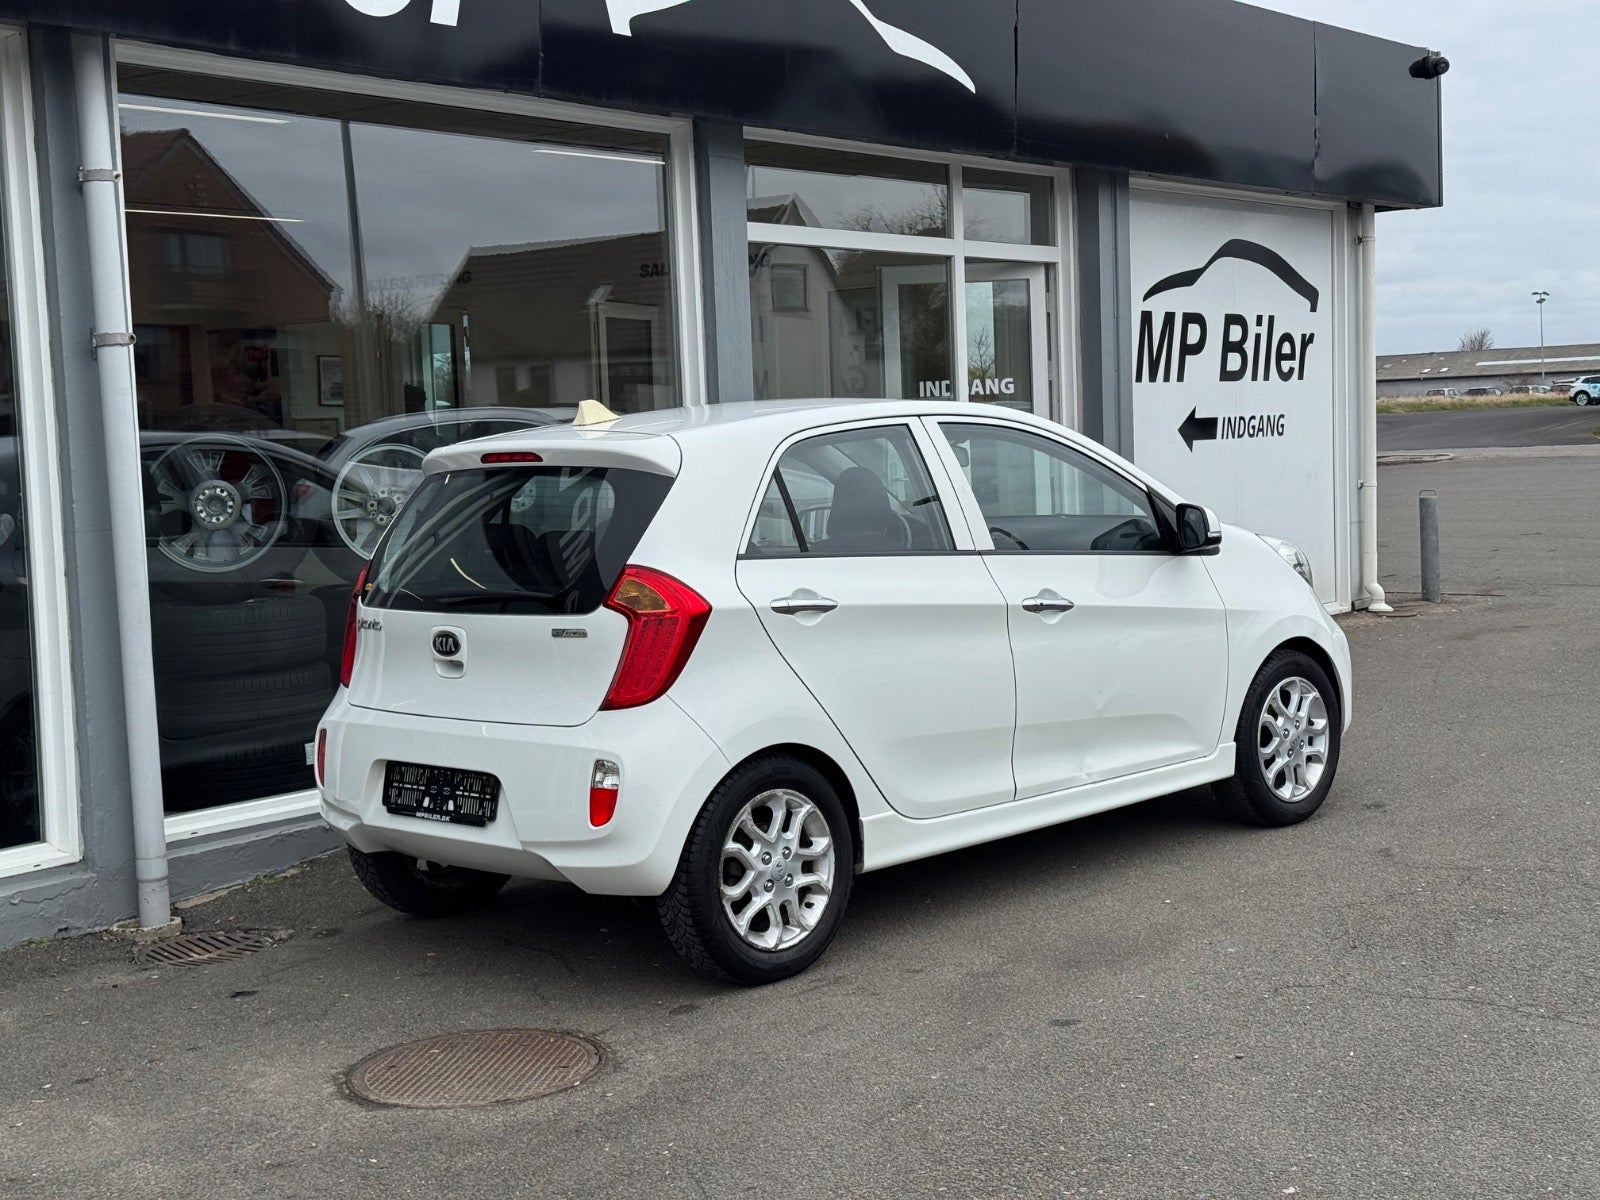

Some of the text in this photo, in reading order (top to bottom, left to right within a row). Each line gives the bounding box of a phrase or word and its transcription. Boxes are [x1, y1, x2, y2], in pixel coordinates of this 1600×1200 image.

[1135, 310, 1315, 383] MP Biler
[919, 377, 1015, 398] INDANG
[1221, 413, 1285, 440] INDGANG
[435, 635, 456, 652] KIA
